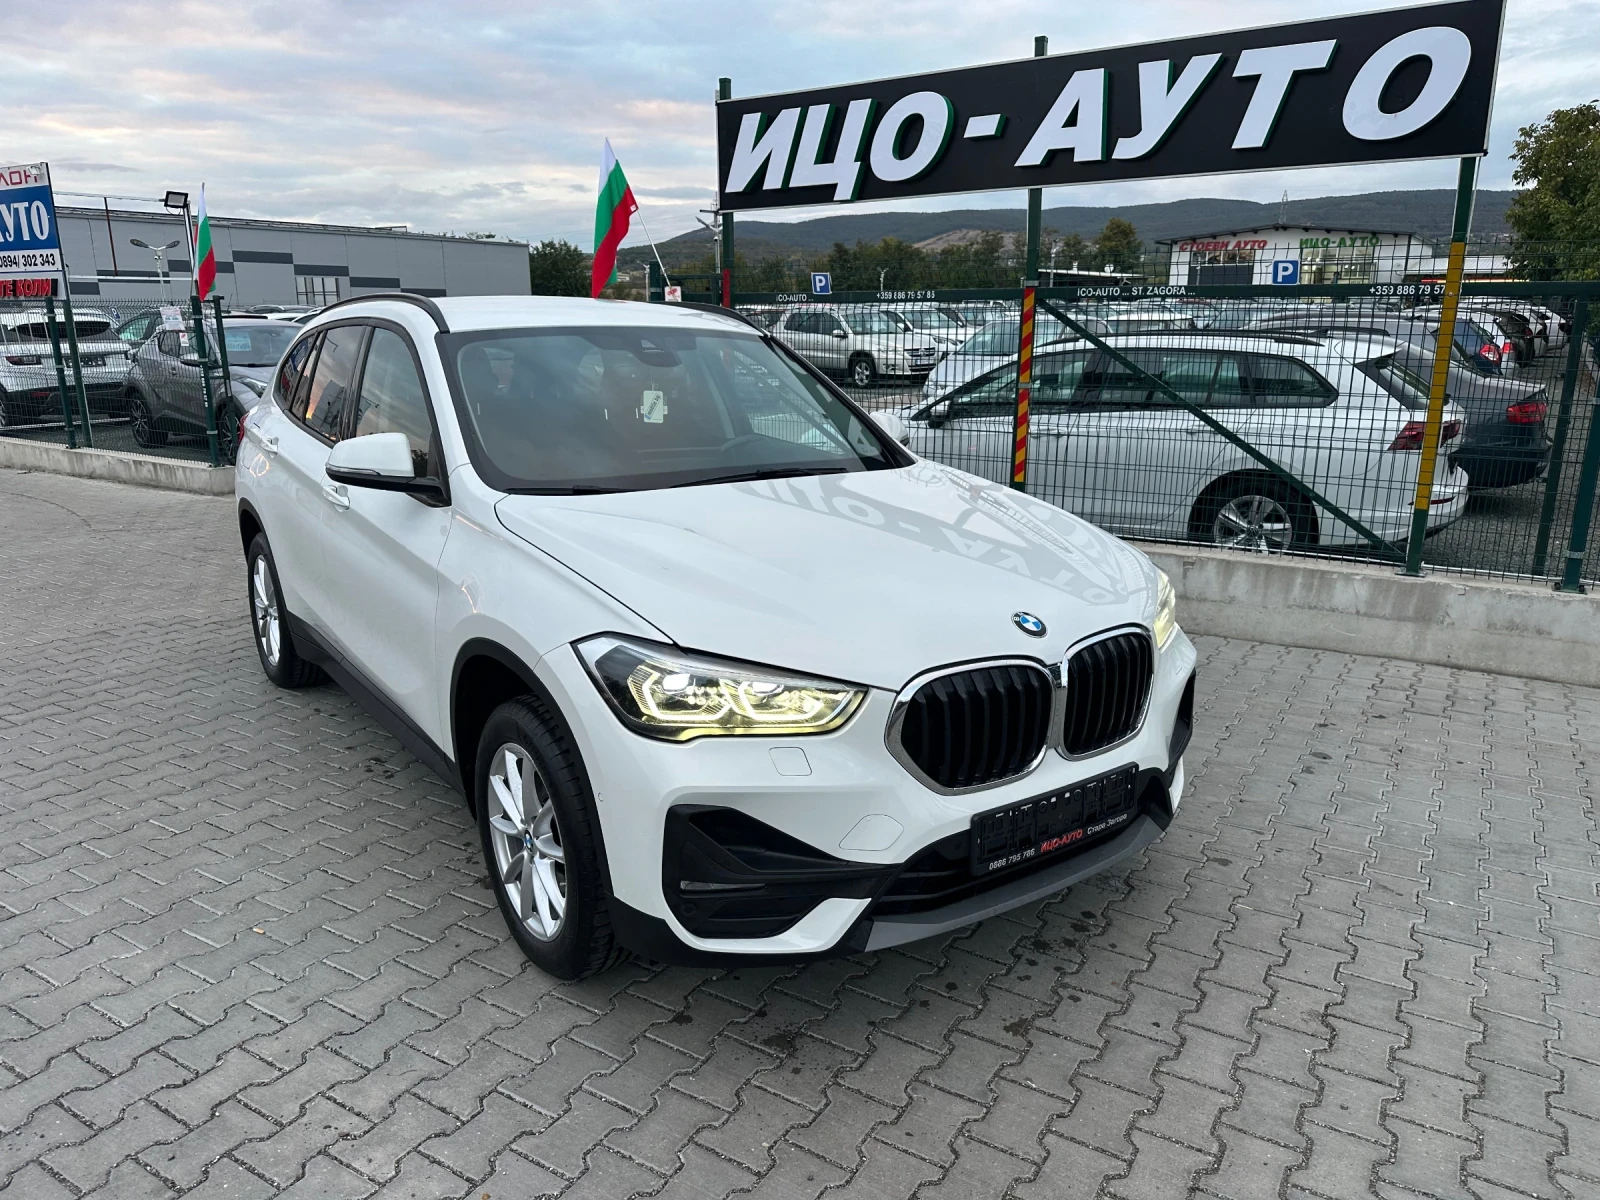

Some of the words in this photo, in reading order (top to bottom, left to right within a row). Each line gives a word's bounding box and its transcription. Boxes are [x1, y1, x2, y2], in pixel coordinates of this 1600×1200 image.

[725, 26, 1472, 200] ИЦО-АУТО
[0, 200, 50, 242] УТО
[1179, 240, 1229, 251] СТОЕВИ
[1232, 239, 1268, 250] АУТО
[21, 254, 38, 267] 302
[39, 253, 56, 266] 343
[1278, 262, 1293, 282] P
[15, 278, 52, 297] КОЛИ
[815, 275, 826, 292] P
[1146, 285, 1186, 295] ZAGORA
[1369, 285, 1394, 295] +359
[1396, 285, 1415, 295] 886
[1418, 284, 1431, 295] 79
